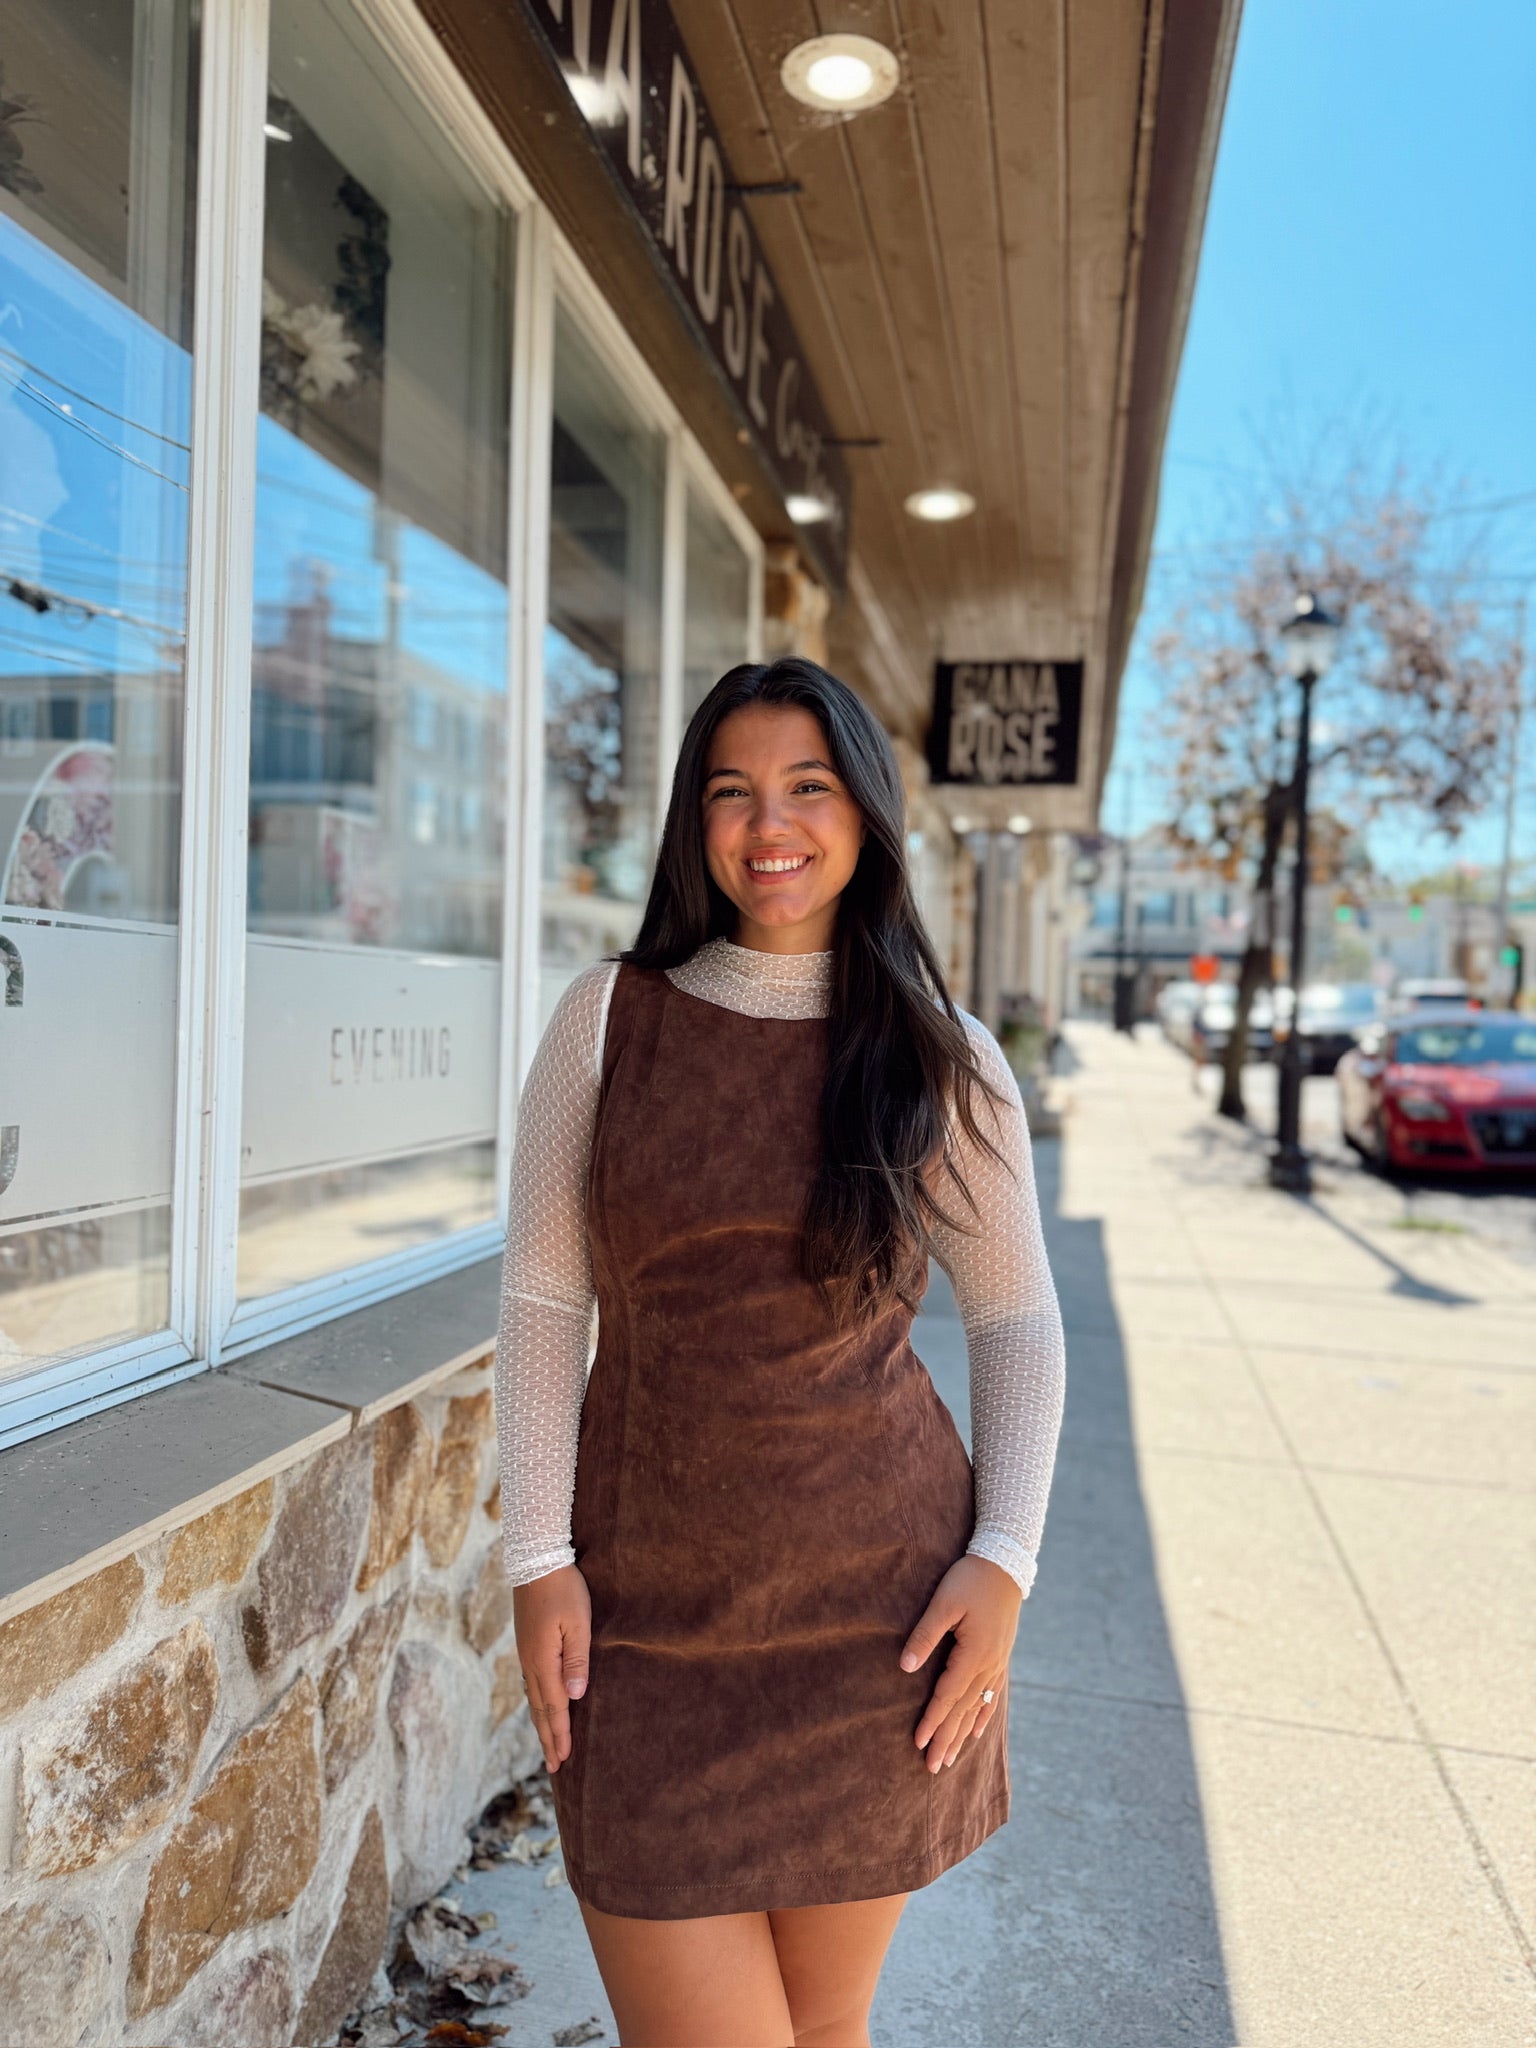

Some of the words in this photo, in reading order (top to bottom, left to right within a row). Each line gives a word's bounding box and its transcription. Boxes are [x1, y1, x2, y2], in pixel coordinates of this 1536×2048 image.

[664, 53, 775, 428] ROSE
[948, 711, 1058, 780] ROSE
[329, 1026, 451, 1085] EVENING
